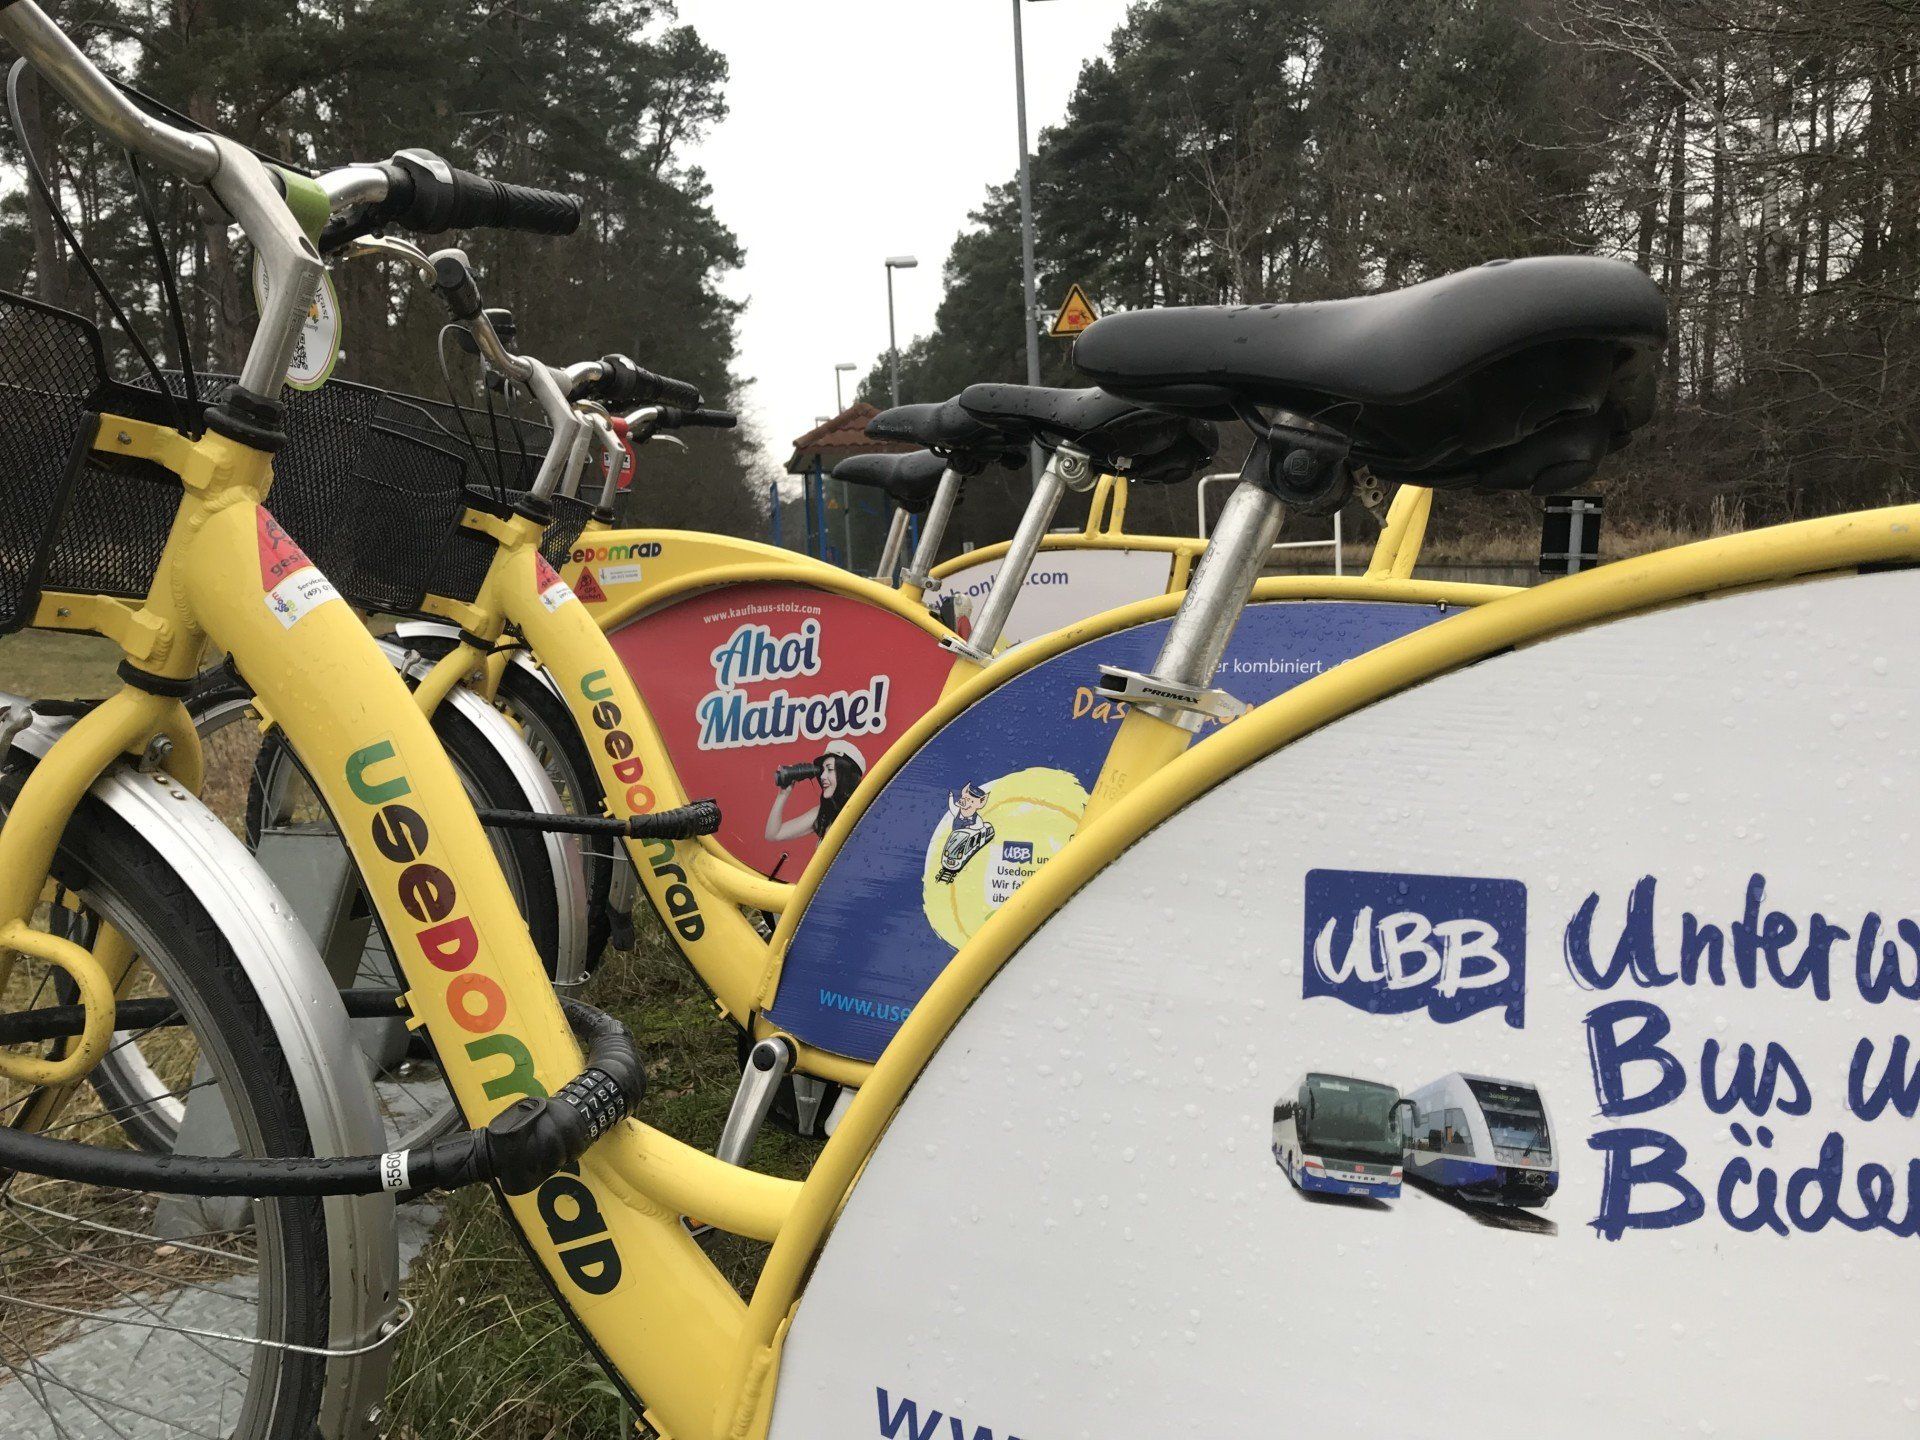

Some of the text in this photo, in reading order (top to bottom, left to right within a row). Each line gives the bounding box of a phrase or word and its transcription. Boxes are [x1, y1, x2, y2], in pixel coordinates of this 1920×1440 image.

[703, 602, 821, 623] www.kaufhaus-stolz.com
[713, 621, 818, 688] Ahoi
[1234, 658, 1322, 674] kombiniert
[1142, 686, 1200, 704] PROMAX
[699, 678, 887, 748] Matrose!
[1004, 846, 1031, 860] UBB
[992, 879, 1009, 889] Wir
[1312, 906, 1510, 998] UBB
[1582, 1000, 1811, 1118] Bus
